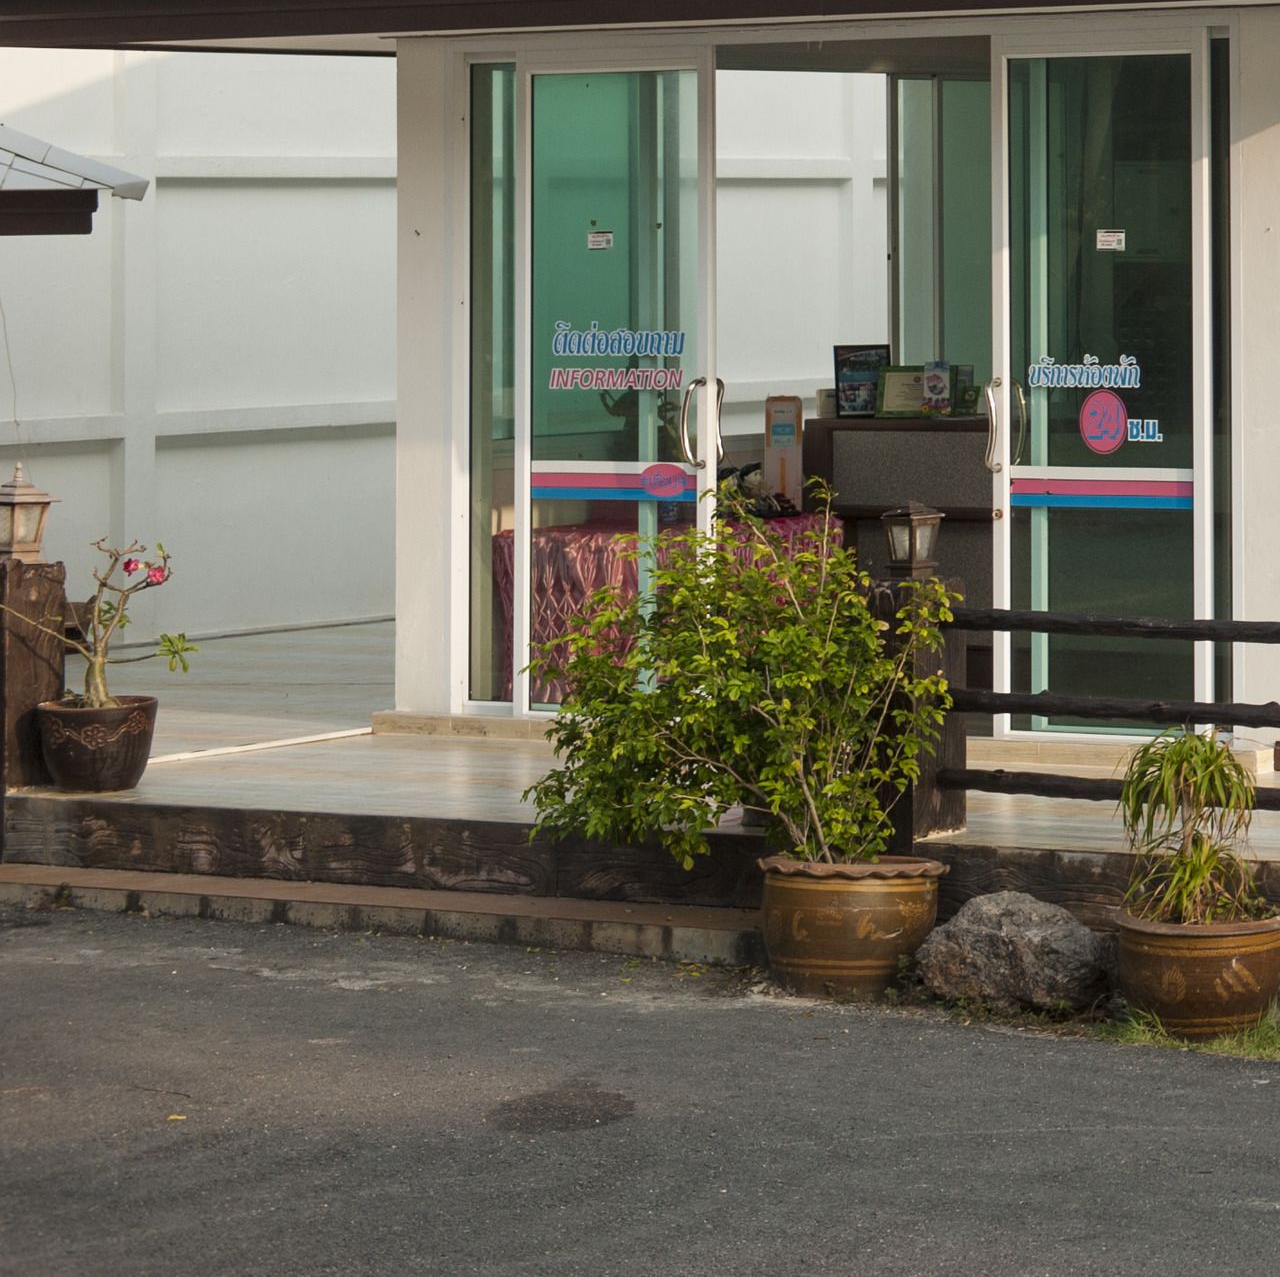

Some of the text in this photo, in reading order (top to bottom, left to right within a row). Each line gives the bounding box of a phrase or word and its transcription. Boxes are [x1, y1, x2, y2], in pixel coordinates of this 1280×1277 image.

[552, 320, 686, 356] ติดต่อสอบถาม
[549, 367, 684, 390] INFORMATION
[1028, 353, 1141, 389] บริการห้องพัก
[1086, 401, 1164, 442] 24 ช.ม.
